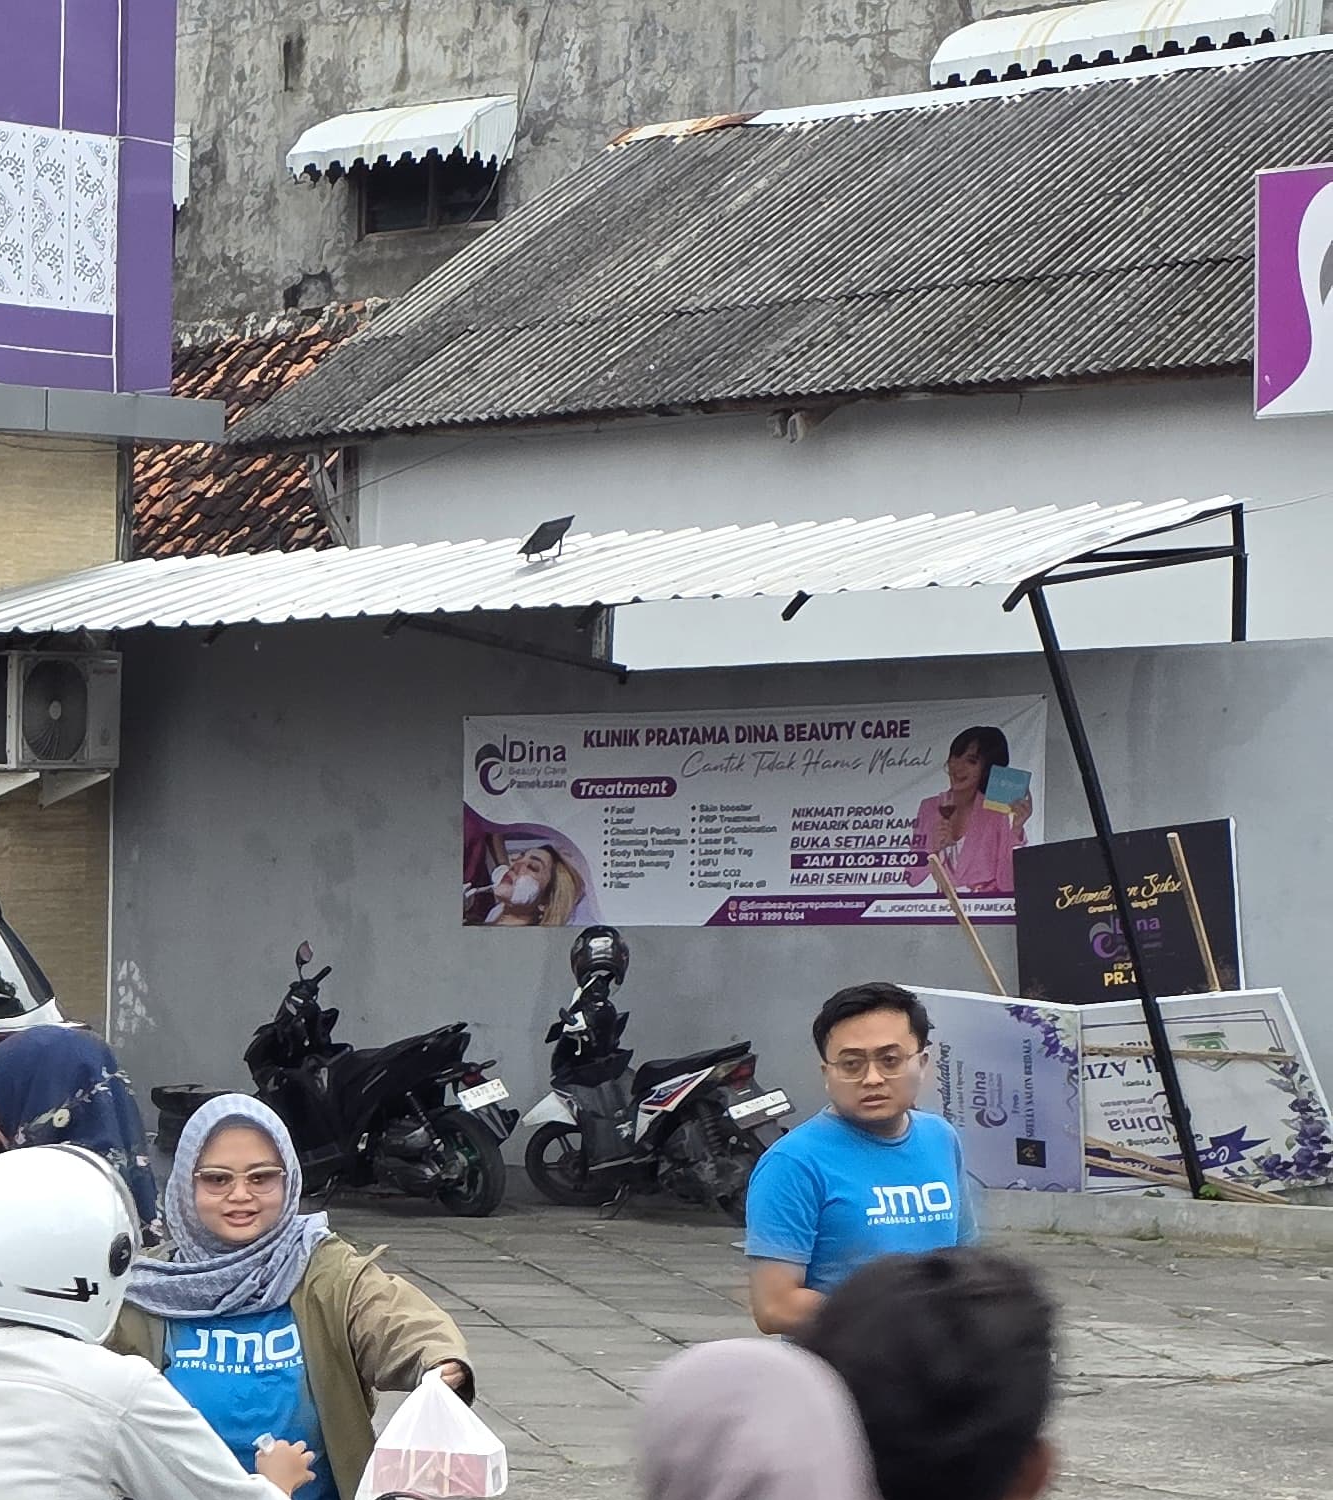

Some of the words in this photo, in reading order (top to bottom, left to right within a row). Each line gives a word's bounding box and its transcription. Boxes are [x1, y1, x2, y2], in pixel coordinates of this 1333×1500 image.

[583, 729, 640, 748] KLINIK
[645, 726, 730, 746] PRATAMA
[734, 723, 779, 743] DINA
[784, 721, 856, 742] BEAUTY
[861, 719, 911, 739] CARE
[508, 740, 567, 763] Dina
[579, 780, 668, 797] Treatment
[791, 806, 848, 819] NIKMATI
[847, 804, 895, 817] PROMO
[791, 819, 851, 832] MENARIK
[852, 819, 885, 831] DARI
[790, 836, 832, 849] BUKA
[834, 835, 885, 848] SETIAP
[888, 833, 928, 848] HARI
[802, 855, 834, 867] JAM
[838, 853, 919, 867] 10.00-18.00
[790, 872, 825, 885] HARI
[826, 872, 868, 885] SENIN
[870, 871, 912, 885] LIBUR
[1108, 1115, 1162, 1133] Dina
[865, 1181, 952, 1216] JMO
[175, 1322, 302, 1363] JMO
